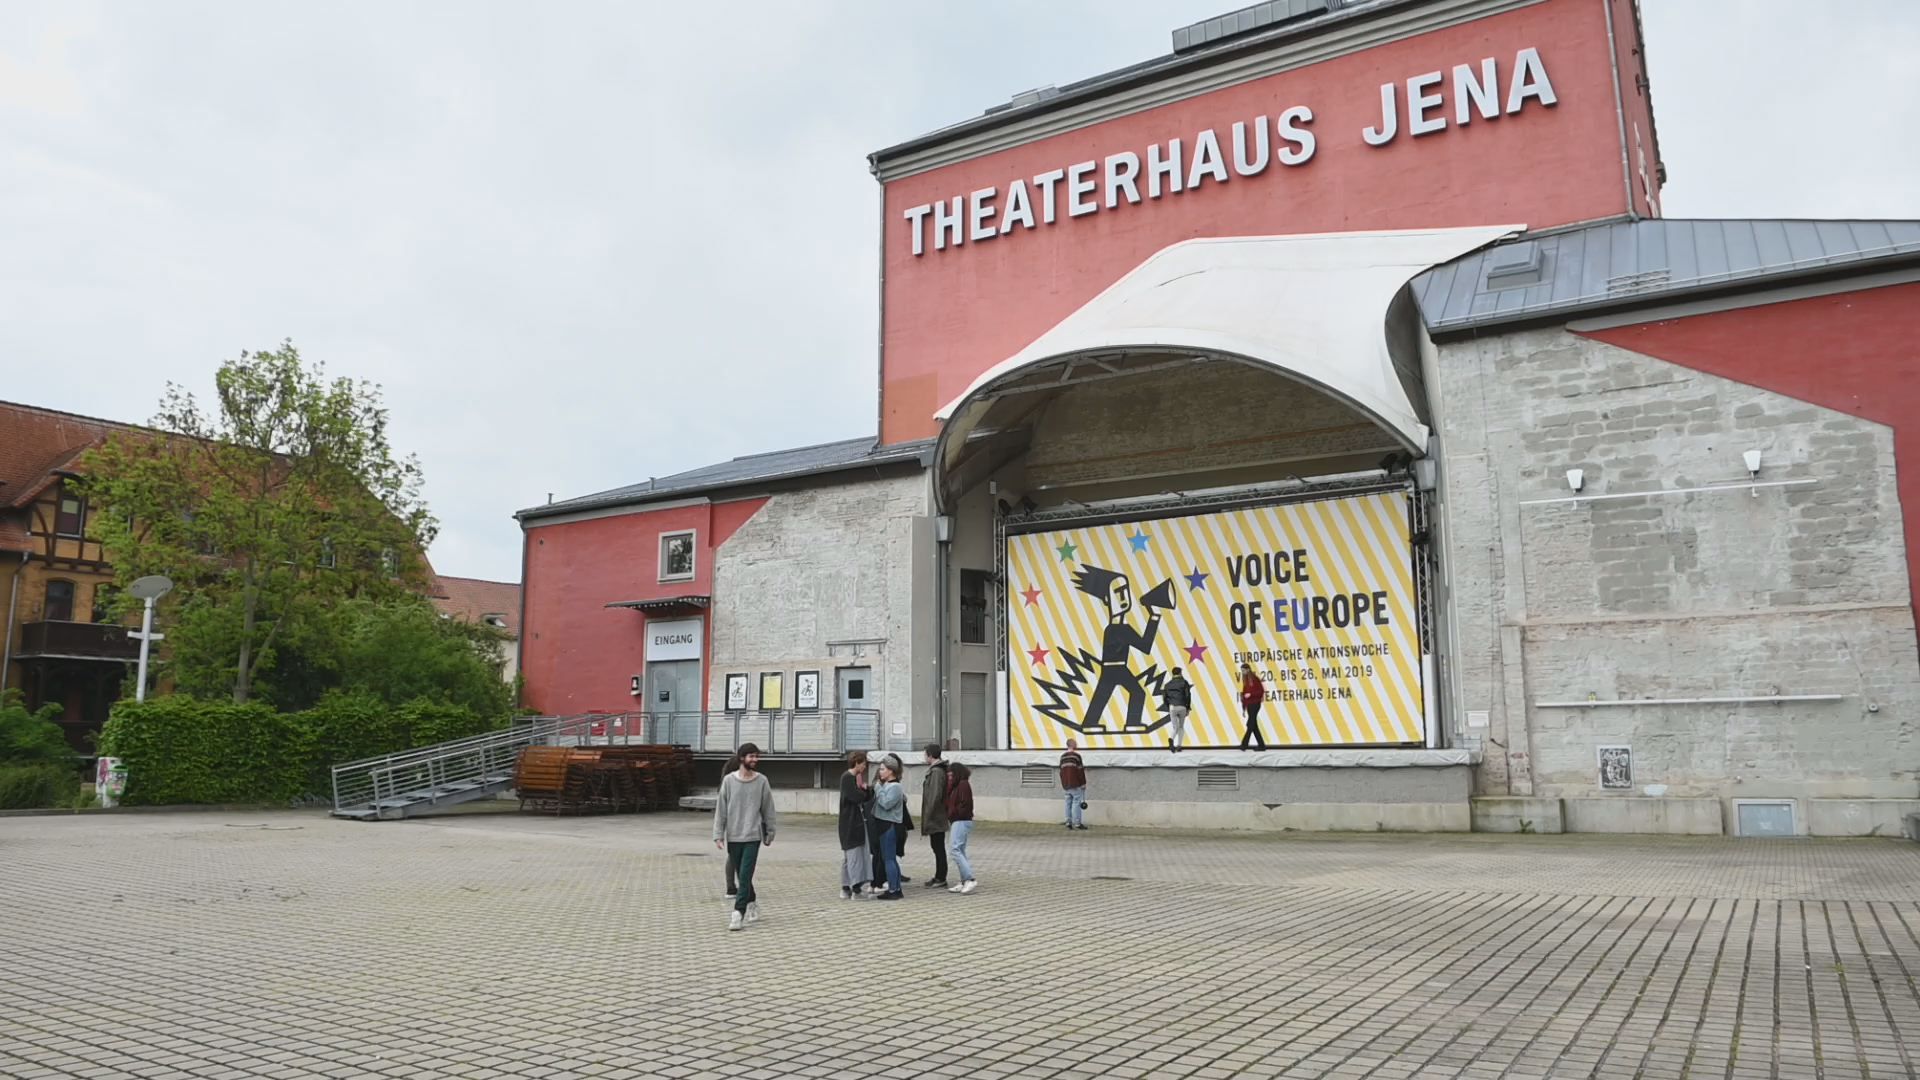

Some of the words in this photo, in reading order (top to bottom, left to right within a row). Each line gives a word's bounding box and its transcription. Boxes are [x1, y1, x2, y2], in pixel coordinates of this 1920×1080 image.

[903, 104, 1317, 256] THEATERHAUS
[1361, 46, 1558, 148] JENA
[1226, 549, 1309, 588] VOICE
[1230, 601, 1262, 635] OF
[1274, 591, 1389, 632] EUROPE
[655, 633, 693, 646] EINGANG
[1234, 648, 1303, 664] EUROPÄISCHE
[1307, 642, 1389, 661] AKTIONSWOCHE
[1260, 670, 1277, 683] 20.
[1280, 669, 1297, 681] BIS
[1300, 668, 1318, 681] 26.
[1321, 666, 1342, 679] MAI
[1345, 664, 1373, 678] 2019
[1264, 688, 1324, 702] EATERHAUS
[1327, 687, 1353, 700] JENA
